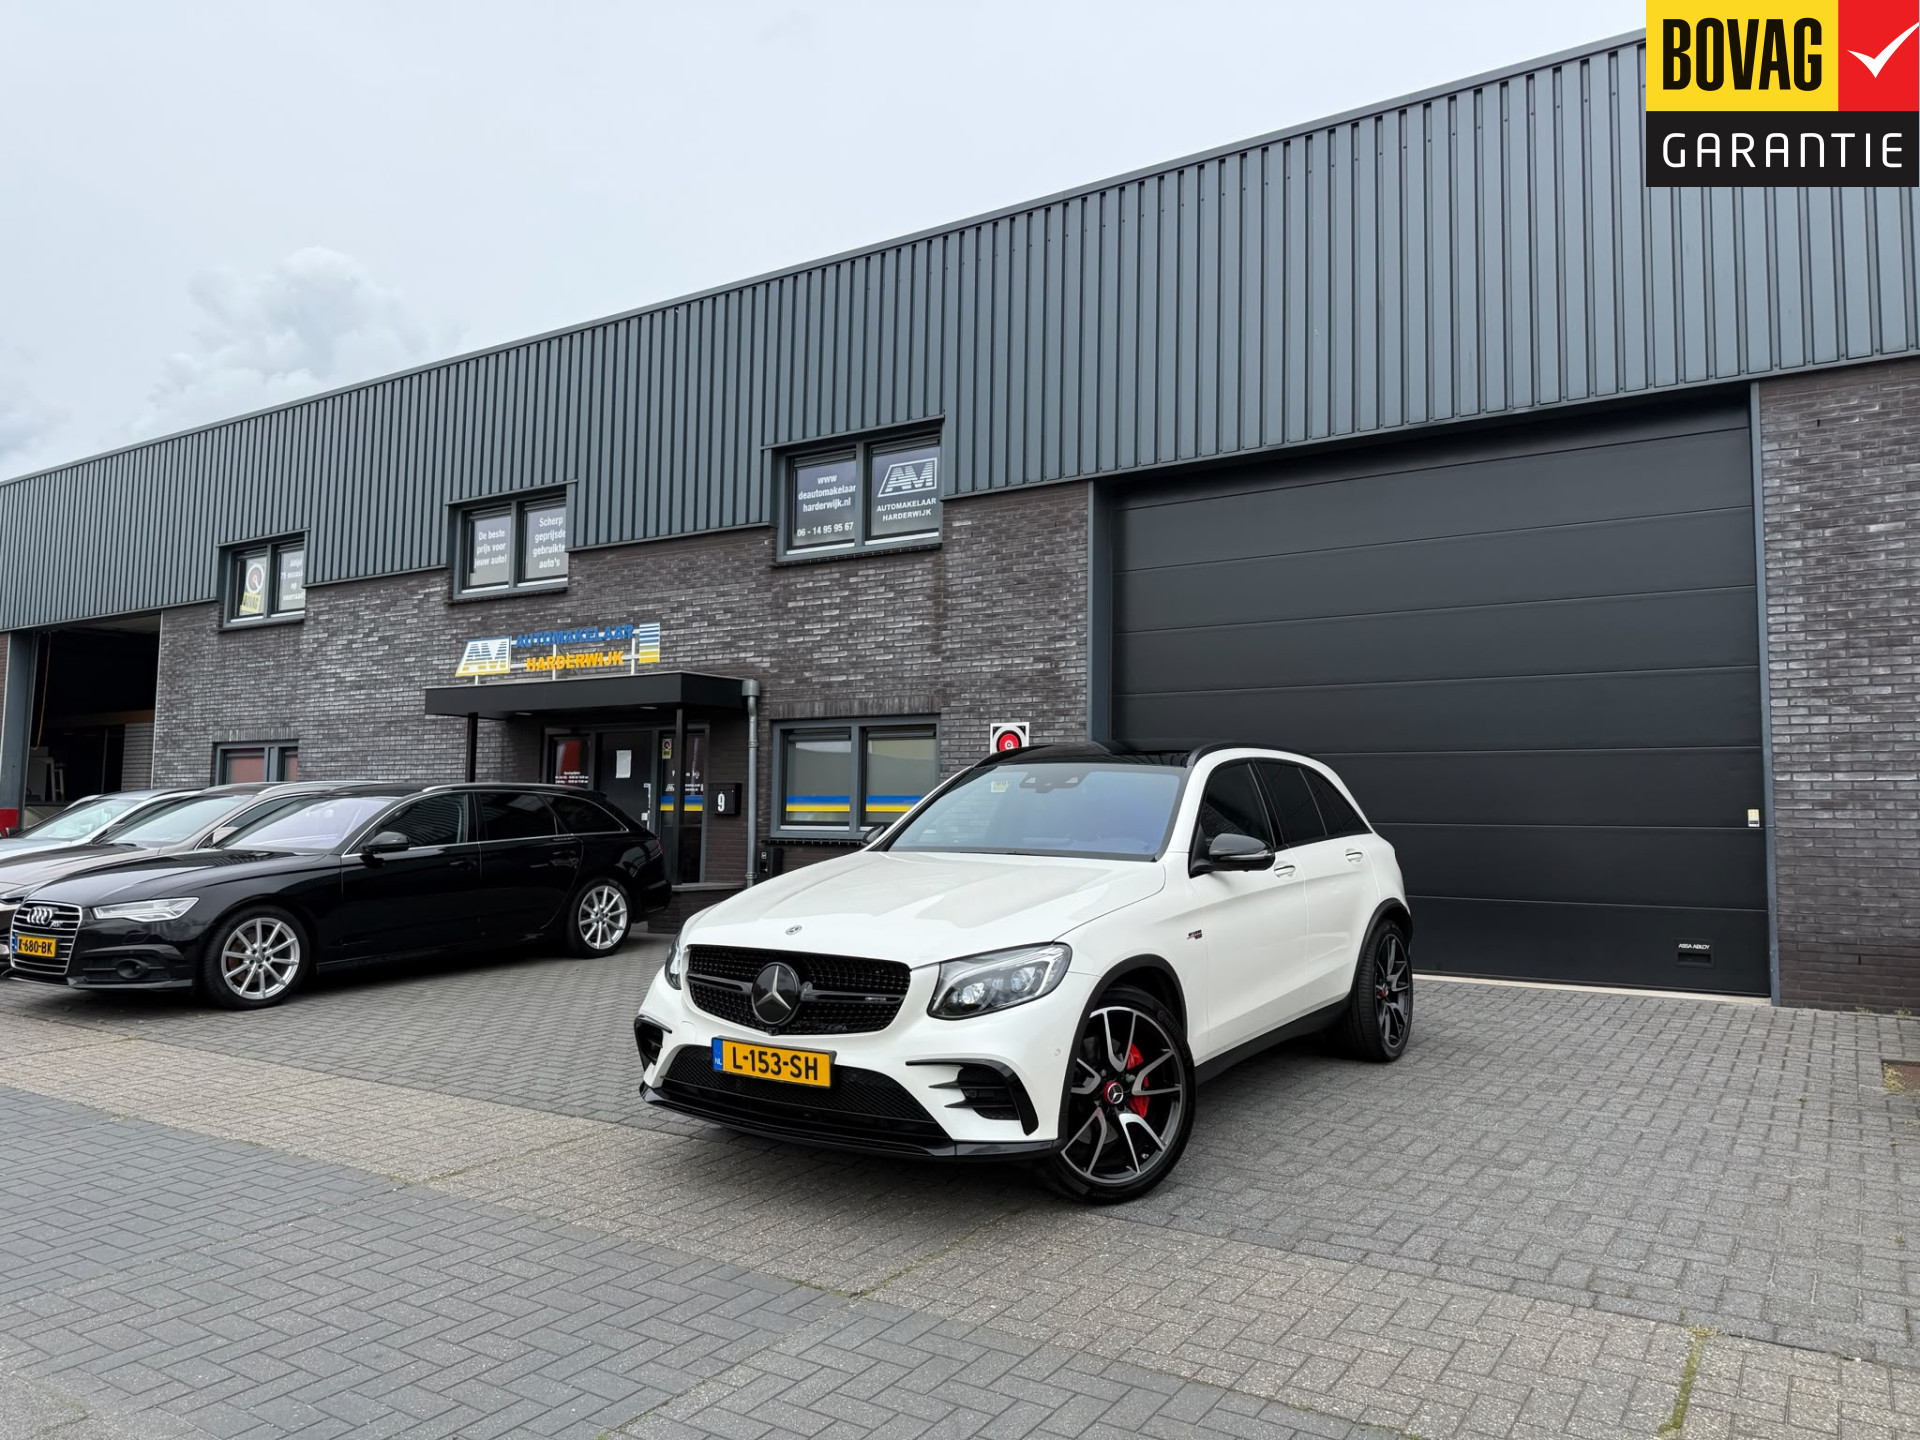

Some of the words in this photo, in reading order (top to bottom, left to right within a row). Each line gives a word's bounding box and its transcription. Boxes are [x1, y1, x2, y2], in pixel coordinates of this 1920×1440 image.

[817, 474, 837, 484] www
[802, 497, 851, 513] harderwijk.nl
[876, 497, 937, 512] AUTOMAKELAAR
[539, 517, 563, 527] Scherp
[882, 508, 932, 522] HARDERWIJK
[478, 531, 486, 540] De
[488, 529, 505, 539] beste
[796, 527, 806, 537] 06
[813, 526, 821, 536] 14
[822, 524, 832, 534] 95
[833, 523, 843, 533] 95
[844, 521, 854, 531] 67
[476, 544, 491, 556] prijs
[492, 542, 506, 552] voor
[538, 557, 561, 569] auto's
[515, 624, 635, 648] AUTOMAKELAAR
[526, 651, 624, 672] HARDERWIJK
[717, 792, 726, 812] 9
[714, 1057, 723, 1066] NL
[732, 1046, 819, 1081] L-153-SH
